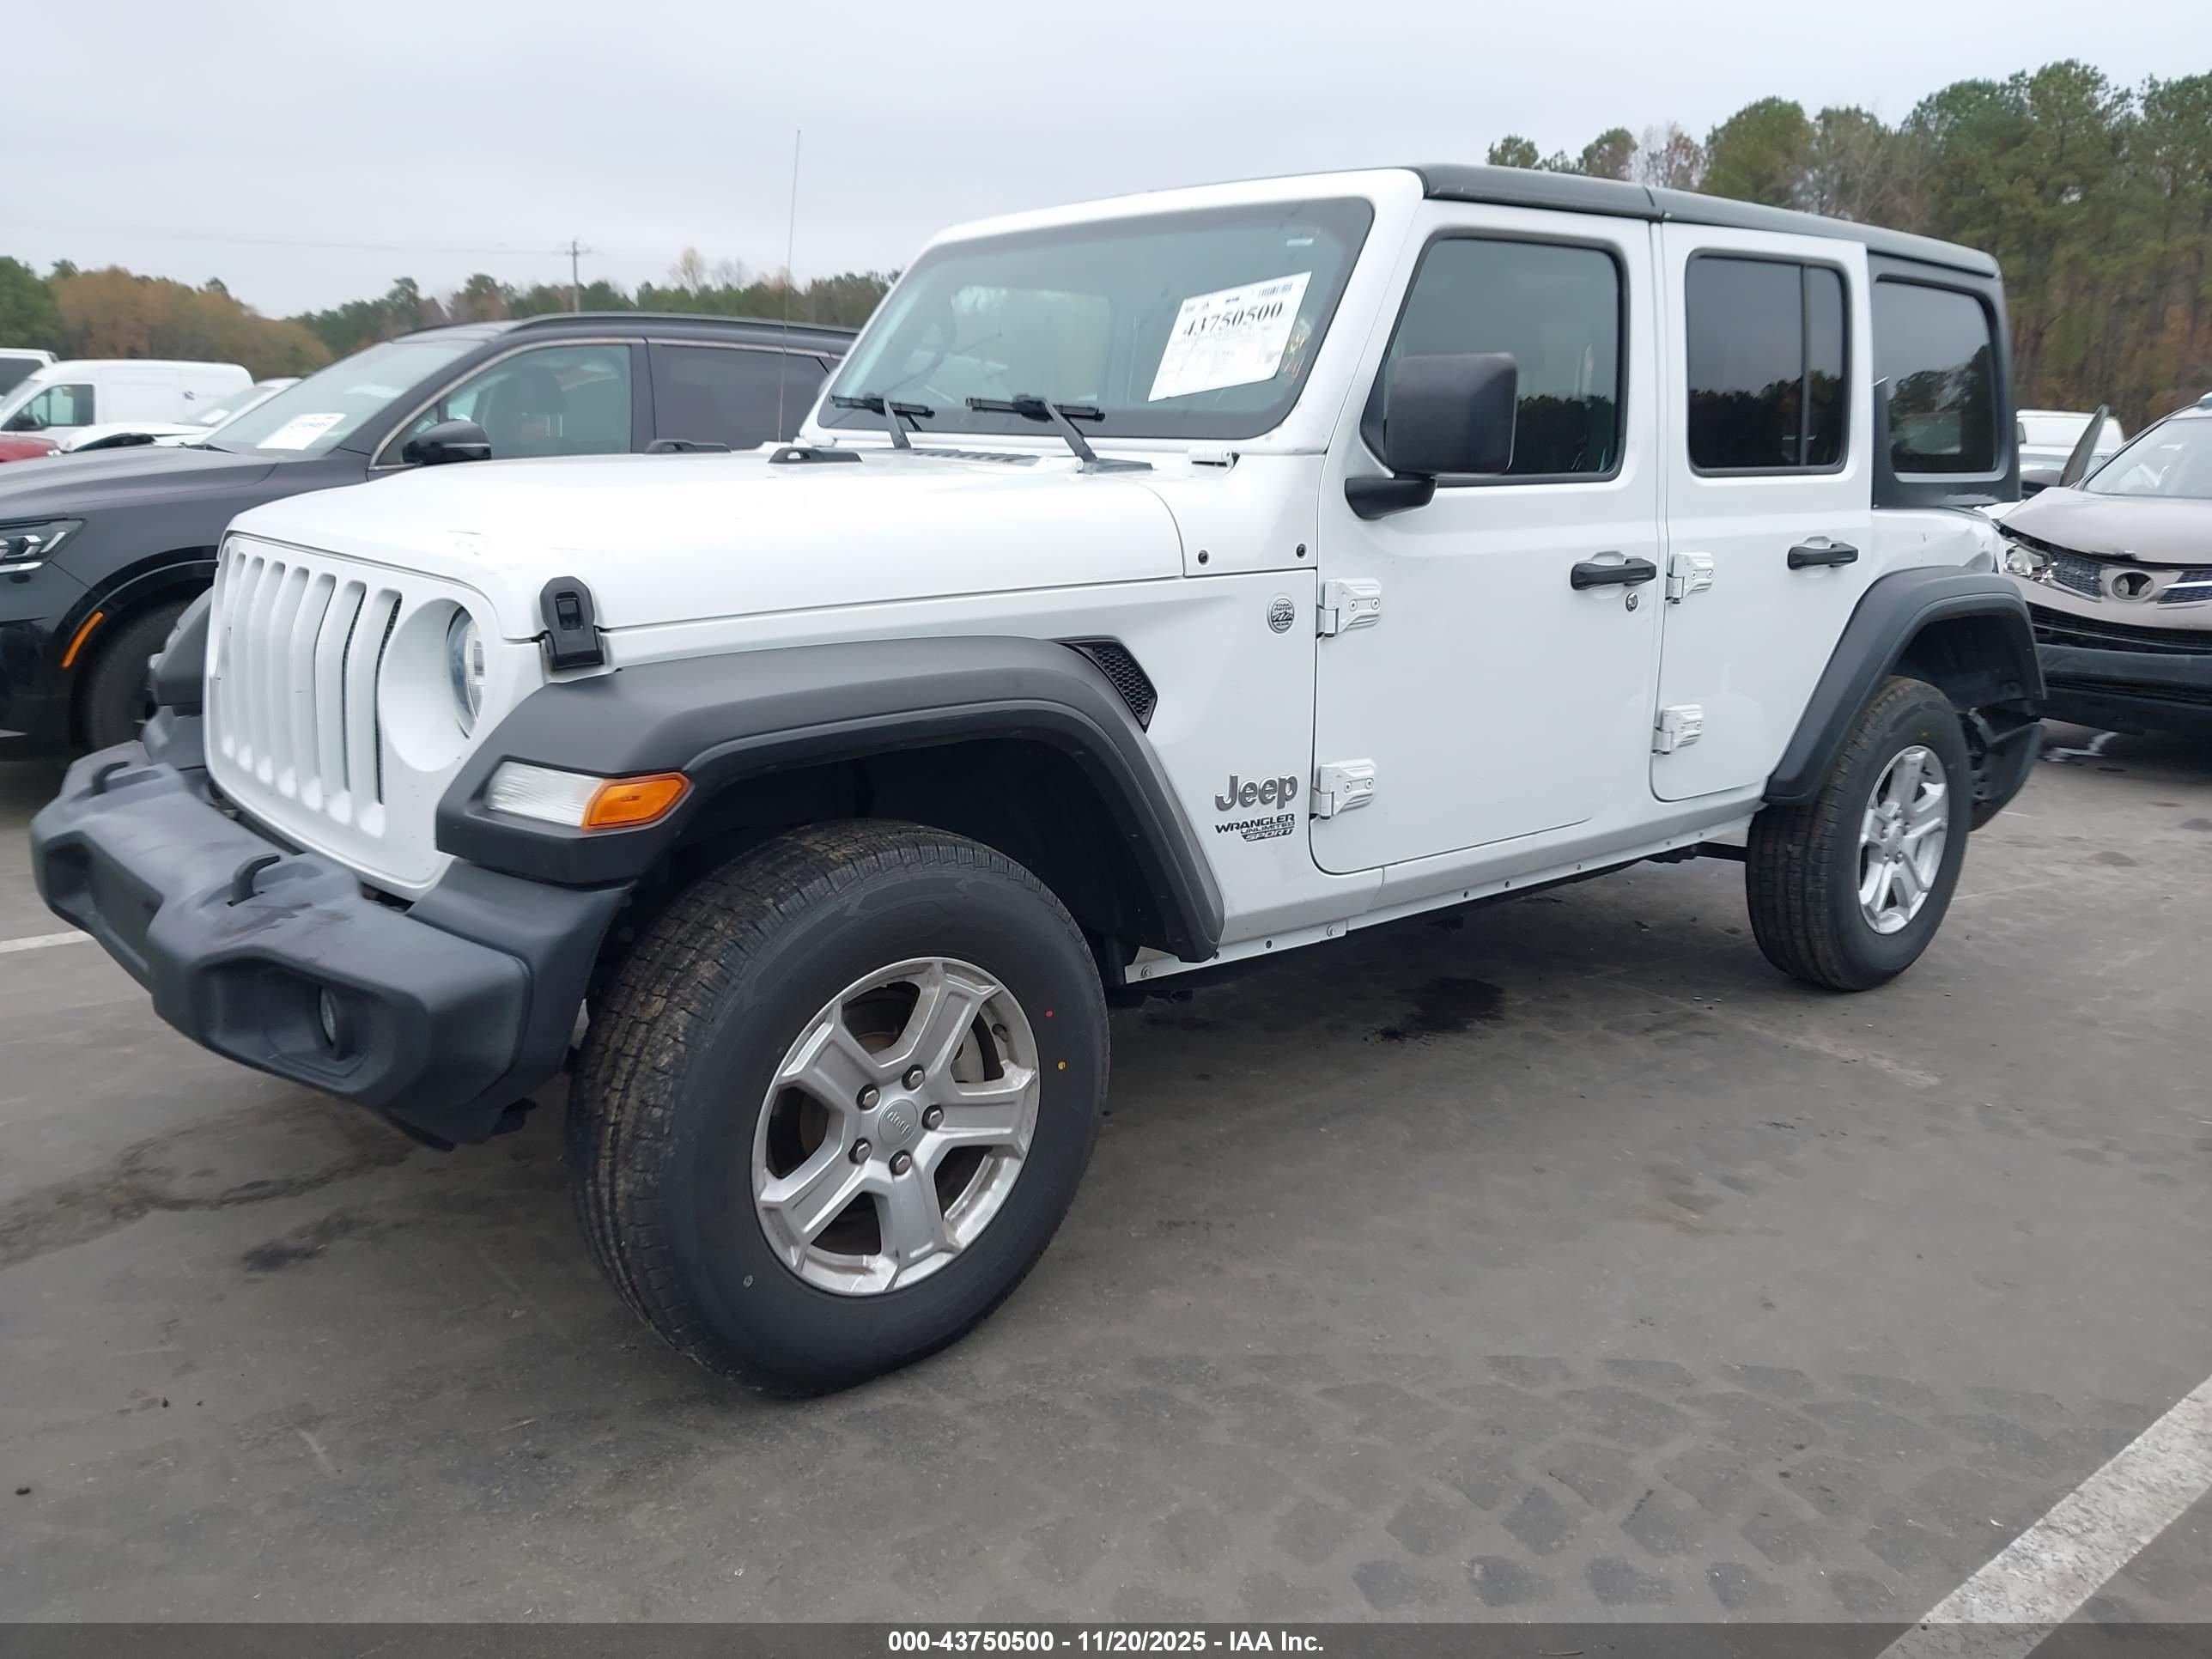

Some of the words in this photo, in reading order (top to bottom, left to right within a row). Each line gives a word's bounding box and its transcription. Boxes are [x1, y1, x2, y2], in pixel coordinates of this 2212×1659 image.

[1183, 301, 1284, 337] 43750500
[1214, 774, 1298, 811] Jeep
[1214, 813, 1295, 834] WRANGLER
[1240, 821, 1295, 835] UNLIMITED
[1244, 829, 1294, 841] SPORT
